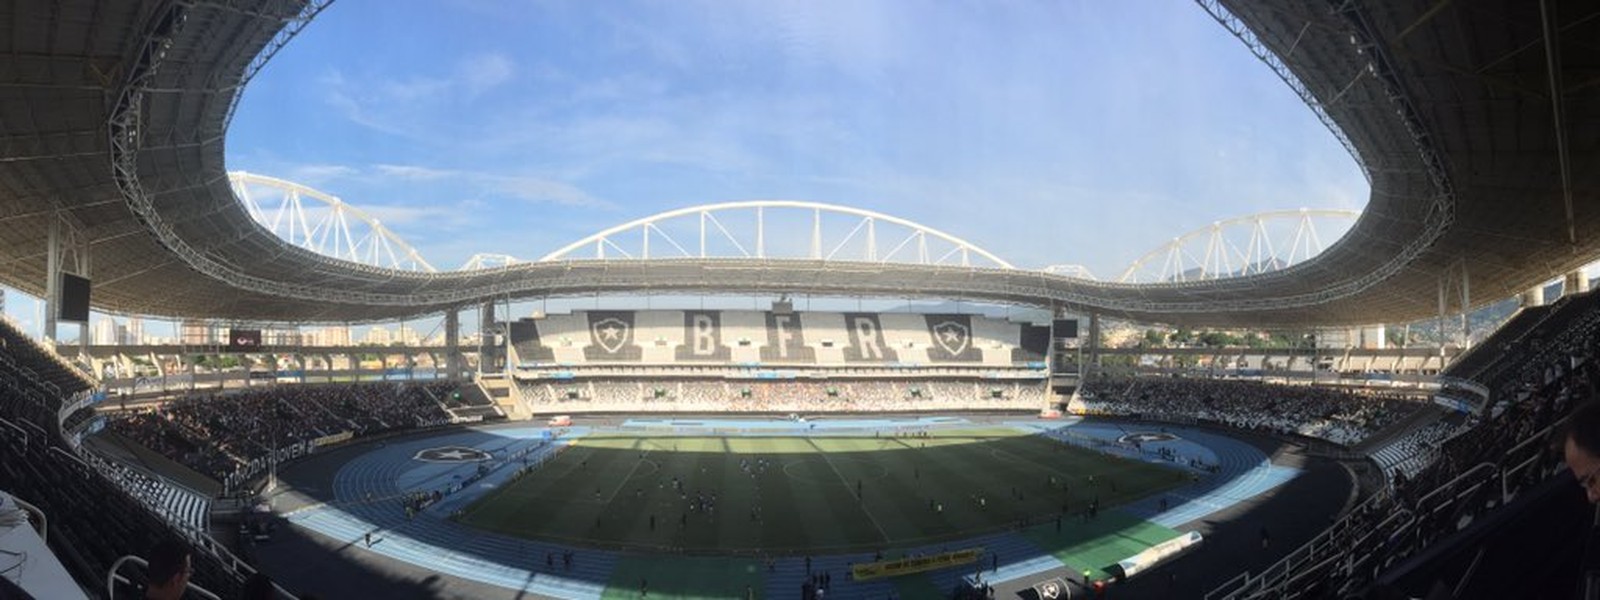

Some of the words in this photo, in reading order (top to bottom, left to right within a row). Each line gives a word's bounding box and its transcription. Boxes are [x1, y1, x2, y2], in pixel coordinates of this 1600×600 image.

[694, 315, 715, 355] B
[776, 316, 793, 357] F
[855, 318, 883, 358] R
